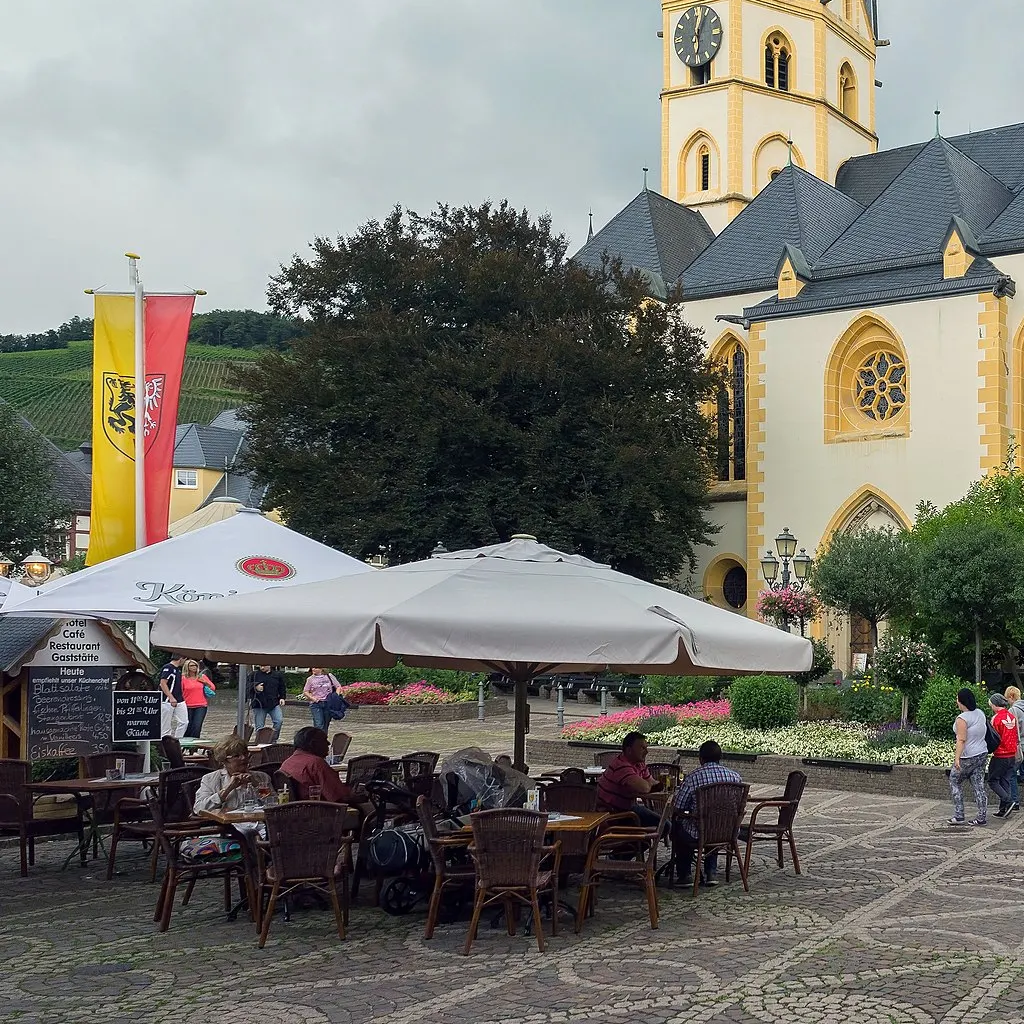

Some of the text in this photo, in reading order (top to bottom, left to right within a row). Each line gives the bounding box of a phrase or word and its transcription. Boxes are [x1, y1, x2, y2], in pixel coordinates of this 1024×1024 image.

[63, 630, 85, 638] Café
[49, 641, 101, 651] Restaurant
[51, 653, 99, 662] Gaststätte
[33, 683, 90, 695] Blattsalate
[143, 696, 159, 704] Uhr
[116, 707, 126, 715] bis
[142, 707, 159, 715] Uhr
[125, 728, 150, 737] Küche
[31, 743, 77, 760] Eiskaffee
